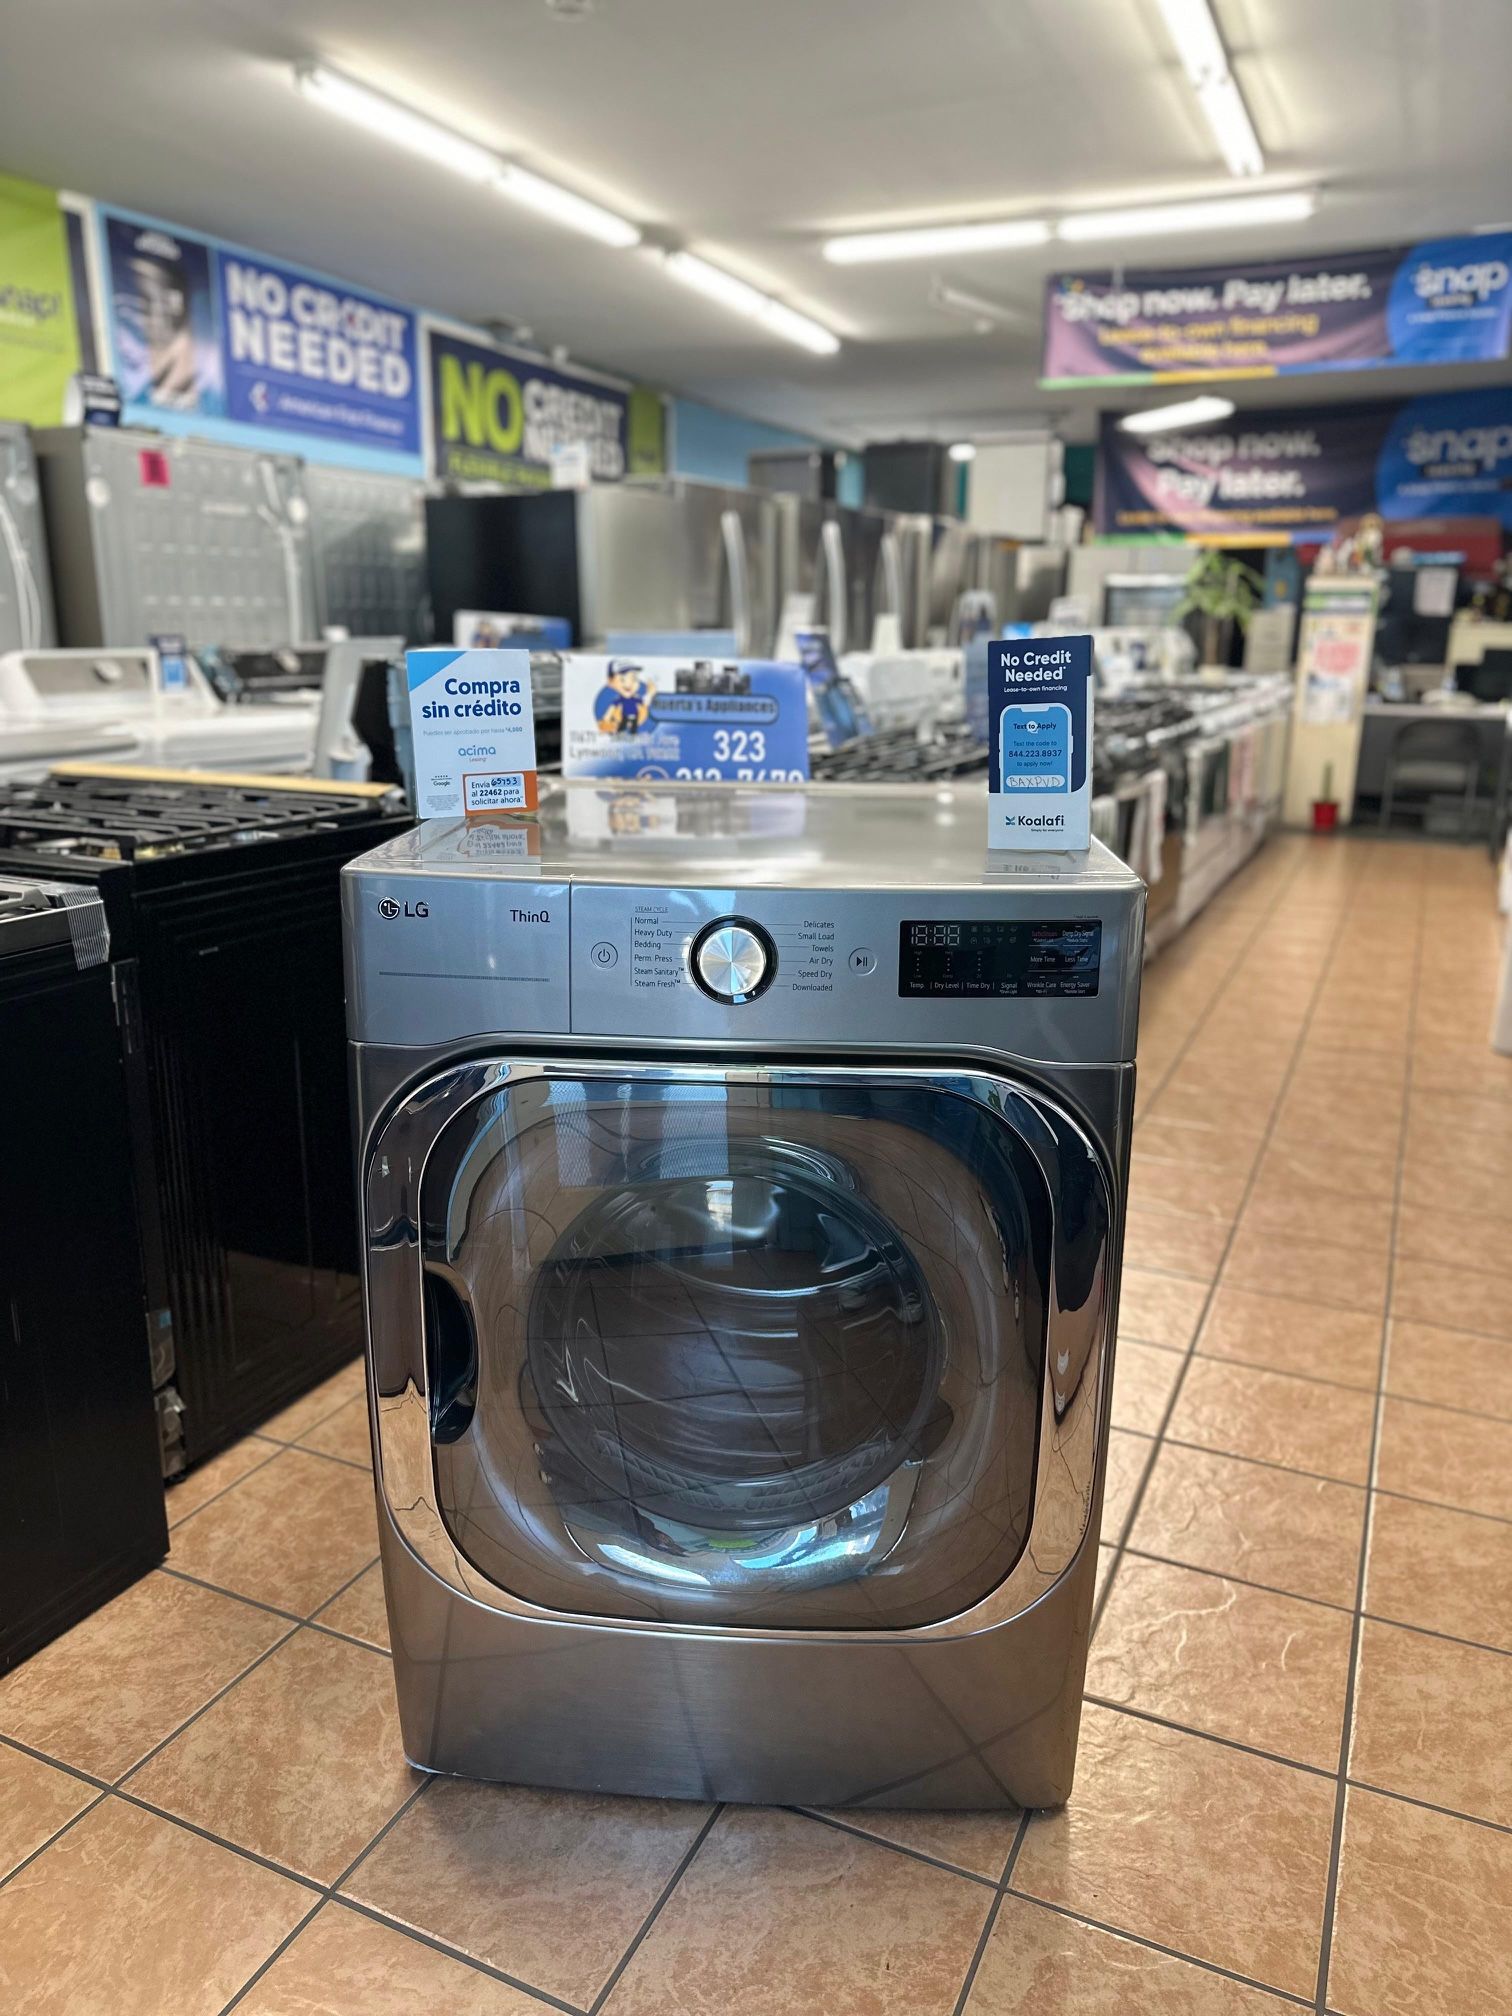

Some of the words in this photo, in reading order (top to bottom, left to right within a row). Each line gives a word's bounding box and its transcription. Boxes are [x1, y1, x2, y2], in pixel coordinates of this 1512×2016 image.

[1412, 260, 1510, 301] snap
[225, 260, 287, 318] NO
[1062, 291, 1140, 325] Shop
[1142, 286, 1218, 316] now.
[1223, 278, 1286, 313] Pay
[1286, 272, 1373, 305] later.
[228, 309, 412, 398] NEEDED
[440, 353, 524, 454] NO
[1156, 467, 1219, 508] Pay
[1218, 467, 1307, 499] later.
[1001, 653, 1020, 667] No
[1024, 650, 1072, 666] Credit
[445, 678, 520, 697] Compra
[422, 701, 450, 718] sin
[454, 699, 522, 718] crédito
[706, 700, 776, 714] Appliances
[1036, 722, 1057, 731] Apply
[458, 745, 496, 756] acima
[713, 730, 766, 762] 323
[1008, 750, 1062, 758] 844.223.8937
[471, 781, 491, 789] Envía
[479, 788, 502, 797] 22462
[503, 789, 520, 797] para
[471, 798, 499, 806] solicitar
[1018, 815, 1065, 826] Koalafi
[404, 901, 429, 918] LG
[510, 909, 550, 923] ThinQ
[804, 920, 835, 928] Delicates
[634, 929, 655, 938] Heavy
[657, 929, 673, 938] Duty
[798, 932, 817, 940] Small
[818, 932, 835, 940] Load
[634, 941, 661, 950] Bedding
[812, 944, 834, 952] Towels
[654, 954, 673, 962] Press
[821, 957, 834, 966] Dry
[634, 967, 653, 975] Steam
[798, 970, 819, 979] Speed
[820, 970, 833, 979] Dry
[792, 983, 833, 991] Downloaded
[934, 982, 944, 990] Dry
[980, 982, 990, 990] Dry
[1001, 982, 1018, 991] Signal
[1060, 981, 1076, 989] Energy
